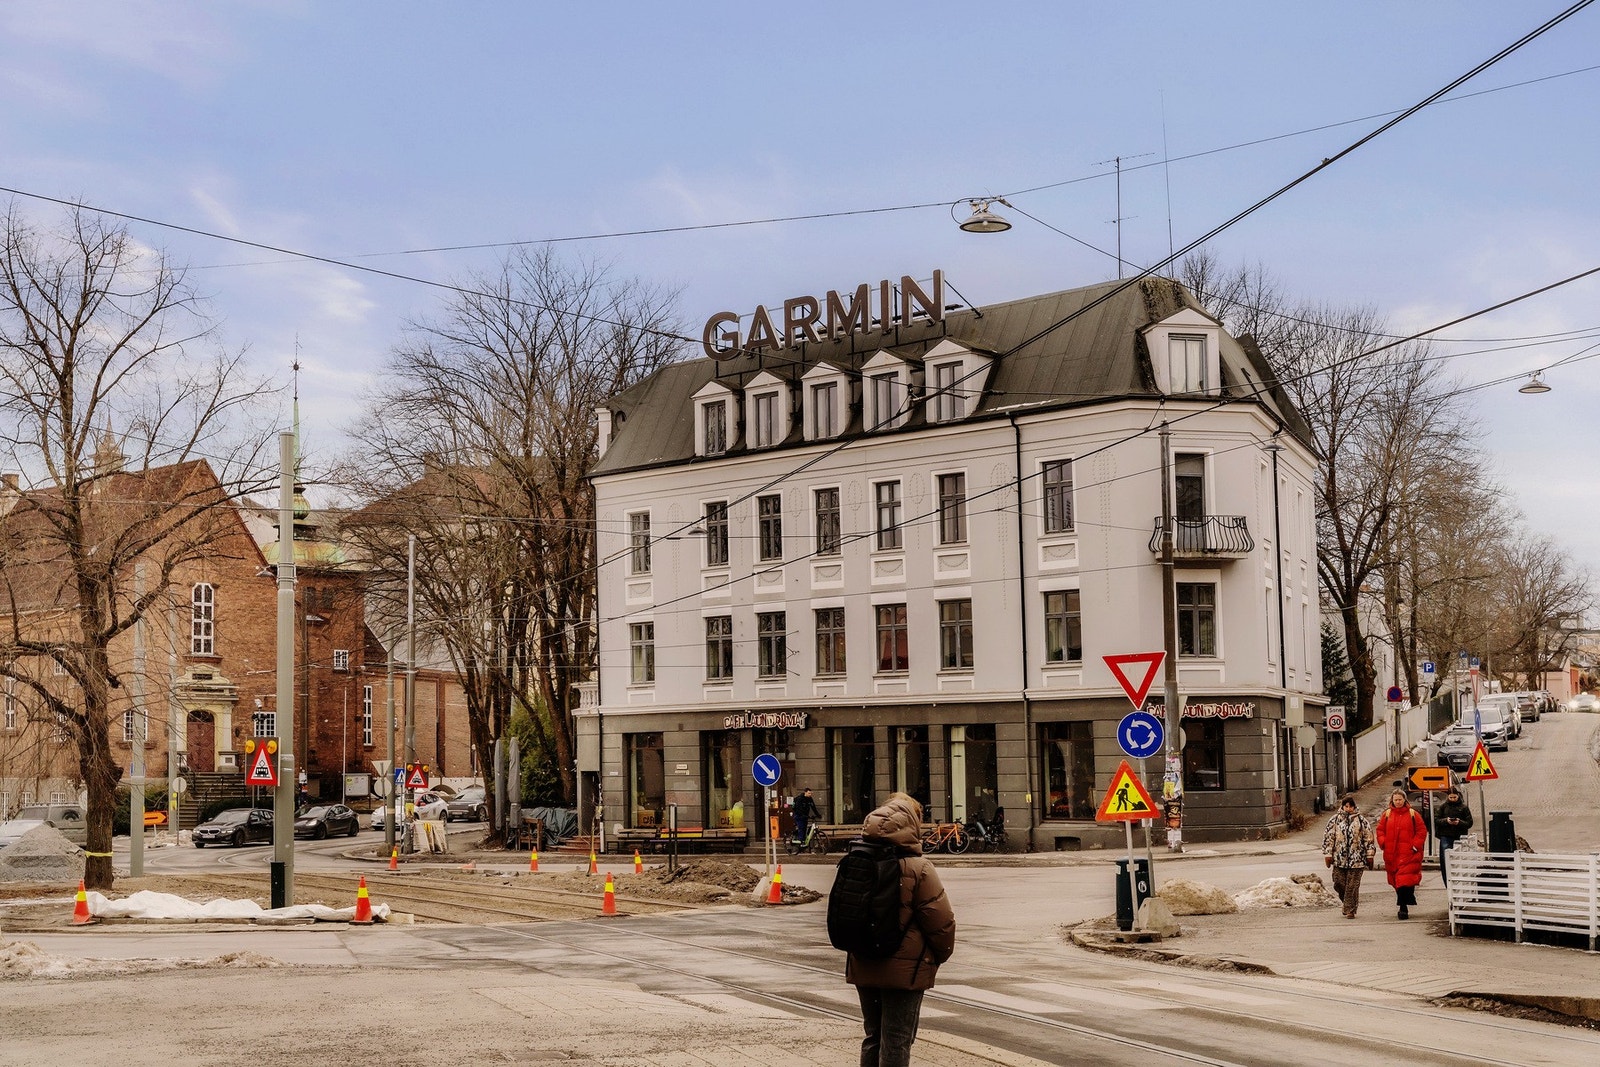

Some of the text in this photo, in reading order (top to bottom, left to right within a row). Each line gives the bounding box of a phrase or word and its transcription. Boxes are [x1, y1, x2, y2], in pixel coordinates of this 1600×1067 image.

[703, 269, 945, 361] GARMIN
[1147, 702, 1254, 719] CAF AUNDROMAT
[745, 711, 807, 729] LAUNDROMAT
[1331, 718, 1341, 726] 30
